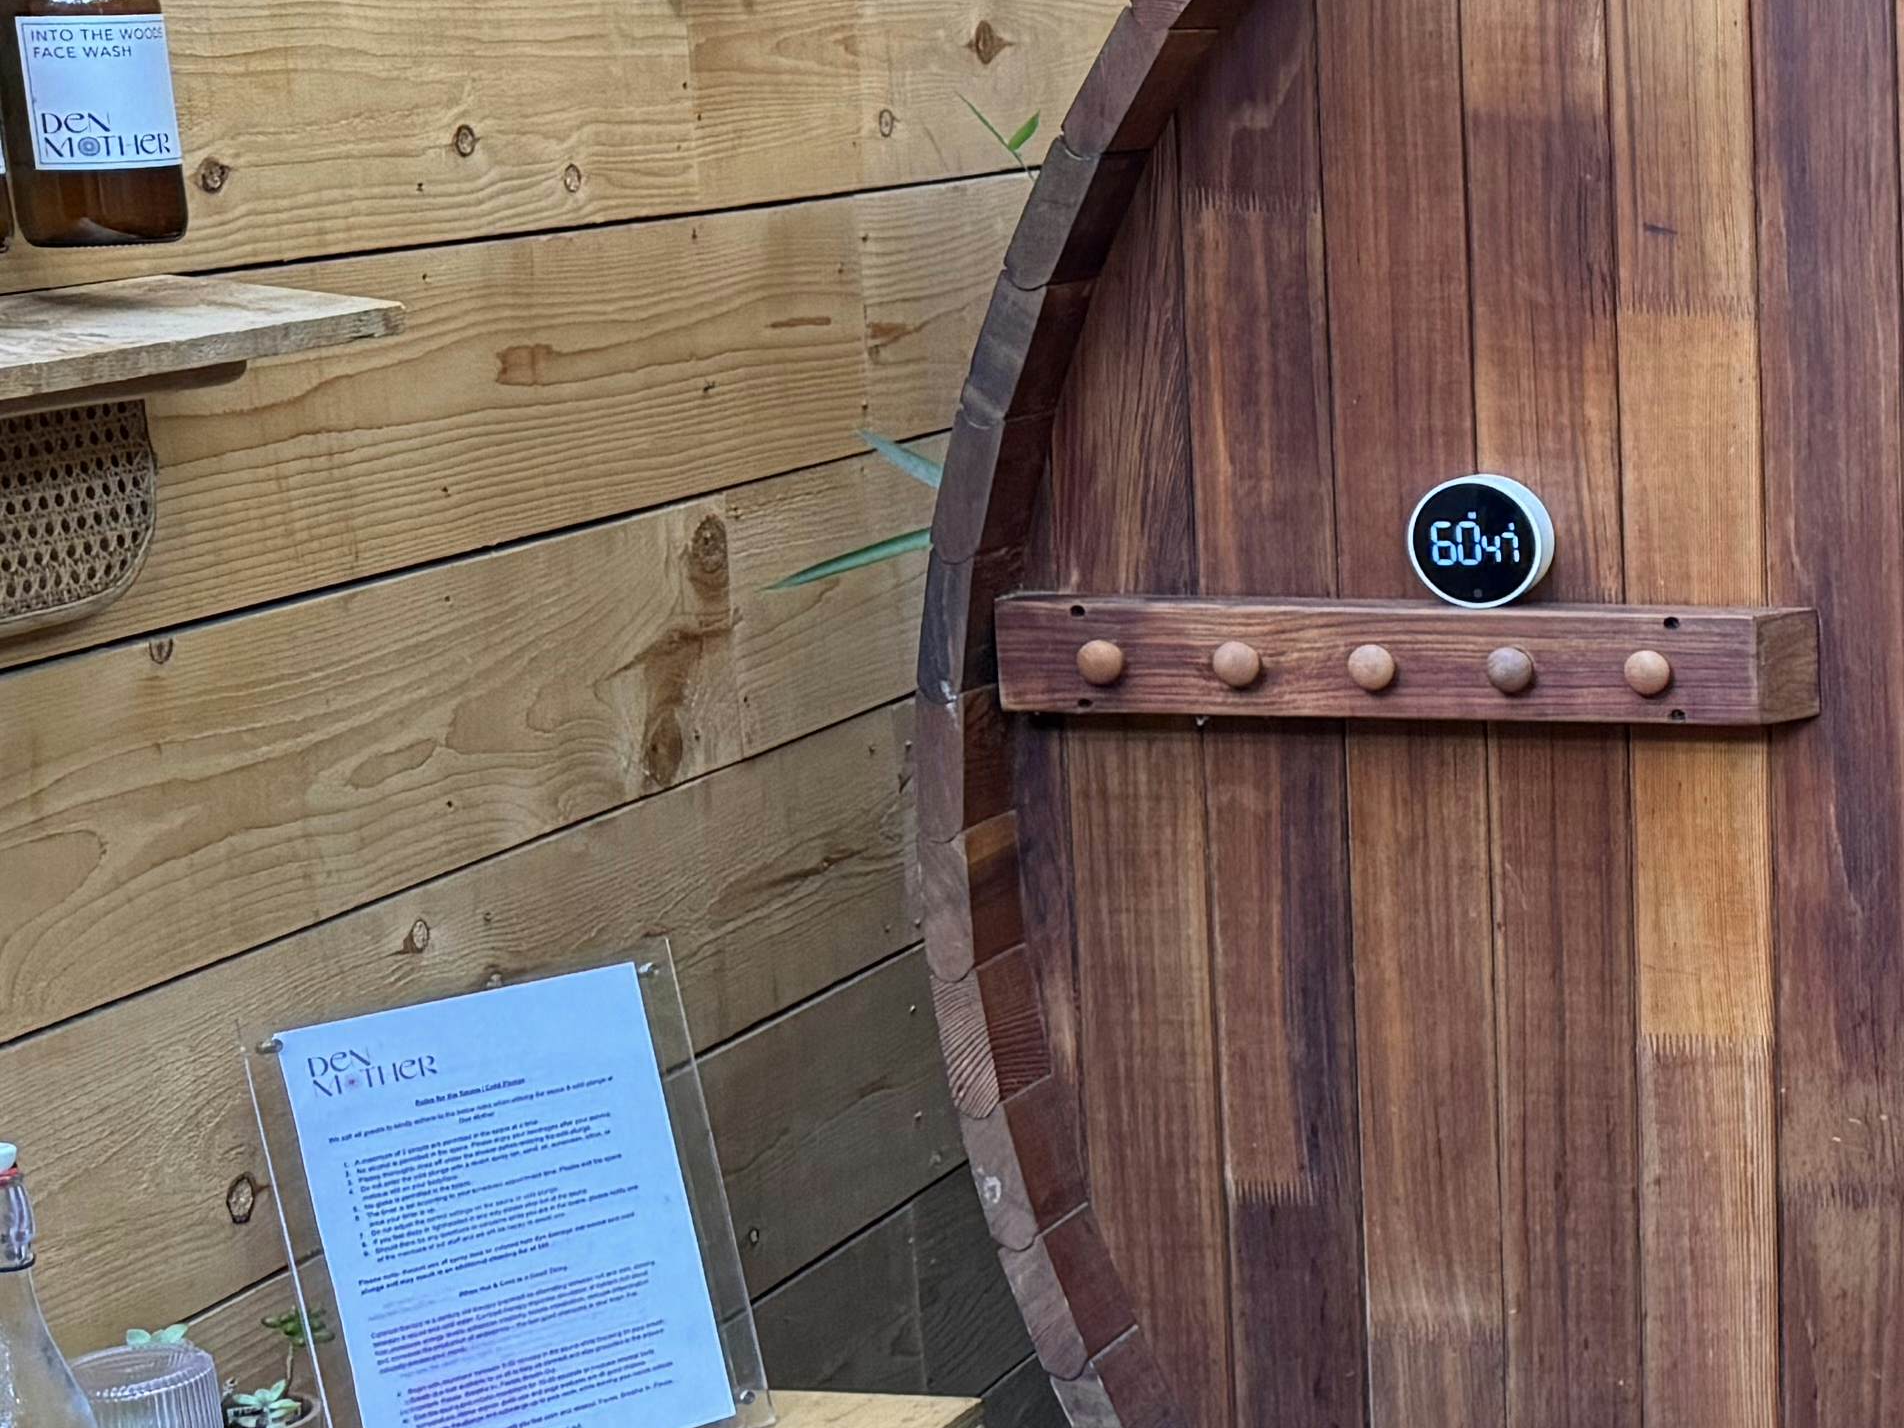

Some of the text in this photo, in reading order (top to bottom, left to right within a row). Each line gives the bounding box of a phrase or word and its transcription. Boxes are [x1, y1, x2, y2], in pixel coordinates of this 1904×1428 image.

[31, 27, 163, 41] INTO THE WOODS
[33, 45, 132, 59] FACE WASH
